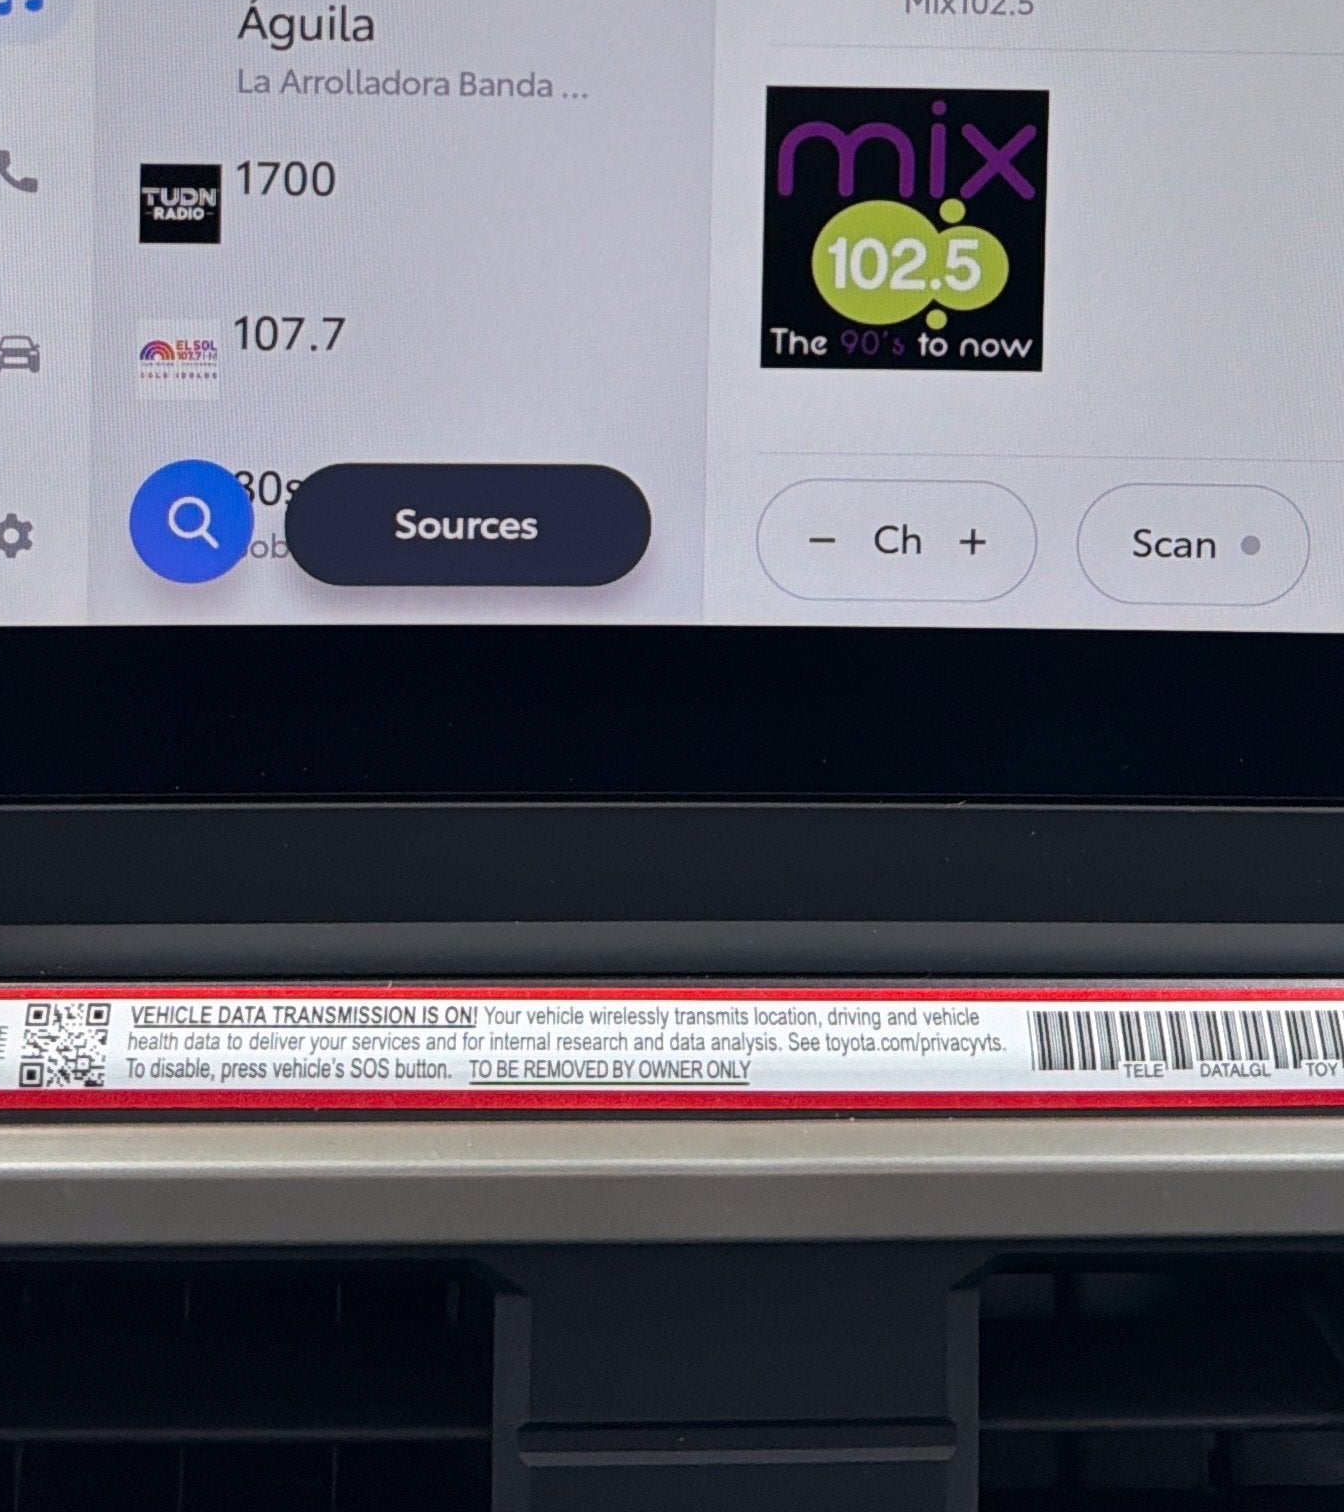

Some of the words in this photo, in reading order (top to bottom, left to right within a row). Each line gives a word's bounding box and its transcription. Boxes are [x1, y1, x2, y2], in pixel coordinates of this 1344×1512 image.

[237, 69, 271, 96] La
[280, 69, 451, 98] Arrolladora
[459, 70, 554, 99] Banda
[777, 100, 1038, 201] mix
[235, 159, 337, 198] 1700
[141, 187, 218, 207] TUDN
[152, 205, 206, 221] RADIO
[826, 236, 983, 292] 102.5
[233, 315, 347, 352] 107.7
[769, 326, 830, 357] The
[840, 329, 907, 358] 90's
[918, 329, 949, 358] to
[959, 331, 1034, 360] now
[394, 508, 538, 542] Sources
[873, 523, 923, 557] Ch
[1131, 527, 1218, 561] Scan
[130, 1005, 213, 1025] VEHICLE
[218, 1005, 268, 1025] DATA
[272, 1005, 416, 1025] TRANSMISSION
[422, 1005, 439, 1025] IS
[444, 1005, 479, 1025] ON!
[484, 1006, 521, 1025] Your
[526, 1006, 585, 1026] vehicle
[589, 1006, 670, 1030] wirelessly
[674, 1006, 750, 1026] transmits
[754, 1006, 823, 1029] location,
[827, 1006, 882, 1030] driving
[887, 1006, 918, 1026] and
[923, 1006, 980, 1026] vehicle
[127, 1031, 179, 1051] health
[183, 1031, 221, 1051] data
[227, 1033, 243, 1051] to
[248, 1031, 306, 1051] deliver
[309, 1036, 348, 1056] your
[351, 1034, 421, 1051] services
[425, 1031, 456, 1051] and
[462, 1031, 485, 1051] for
[489, 1031, 551, 1051] internal
[556, 1031, 630, 1051] research
[633, 1031, 665, 1051] and
[669, 1031, 706, 1052] data
[711, 1031, 783, 1056] analysis.
[787, 1031, 821, 1052] See
[126, 1057, 146, 1079] To
[149, 1057, 216, 1082] disable,
[220, 1061, 268, 1084] press
[271, 1057, 346, 1080] vehicle's
[349, 1057, 391, 1080] SOS
[394, 1057, 454, 1080] button.
[468, 1059, 493, 1079] TO
[496, 1059, 520, 1079] BE
[523, 1059, 609, 1080] REMOVED
[612, 1059, 636, 1080] BY
[638, 1059, 704, 1080] OWNER
[706, 1059, 752, 1080] ONLY
[1123, 1062, 1165, 1078] TELE
[1199, 1061, 1272, 1078] DATALGL
[1304, 1060, 1339, 1077] TOY
